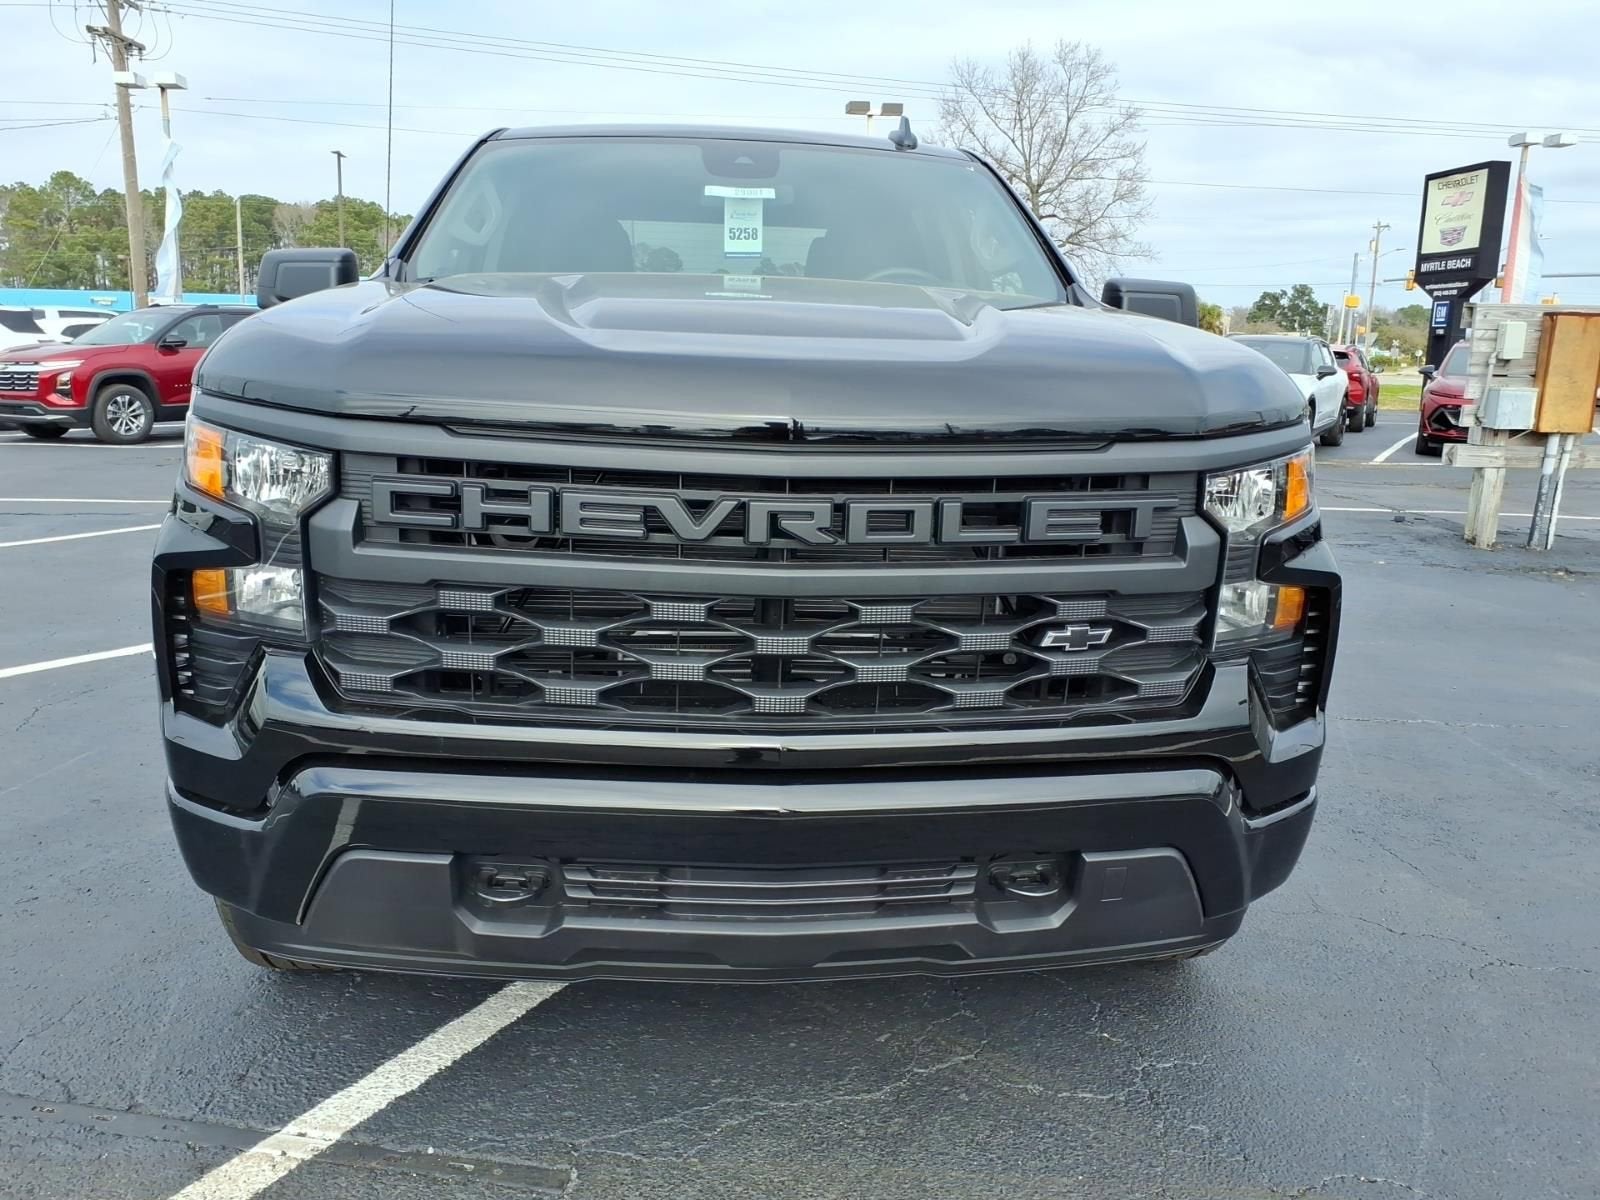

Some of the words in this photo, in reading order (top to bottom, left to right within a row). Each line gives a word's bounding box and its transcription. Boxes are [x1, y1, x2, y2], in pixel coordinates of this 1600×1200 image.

[1437, 174, 1479, 191] CHEVROLET
[729, 227, 758, 240] 5258
[1421, 261, 1446, 272] MYRTLE
[1447, 258, 1471, 269] BEACH
[1436, 306, 1447, 318] GM
[371, 475, 1180, 546] CHEVROLET
